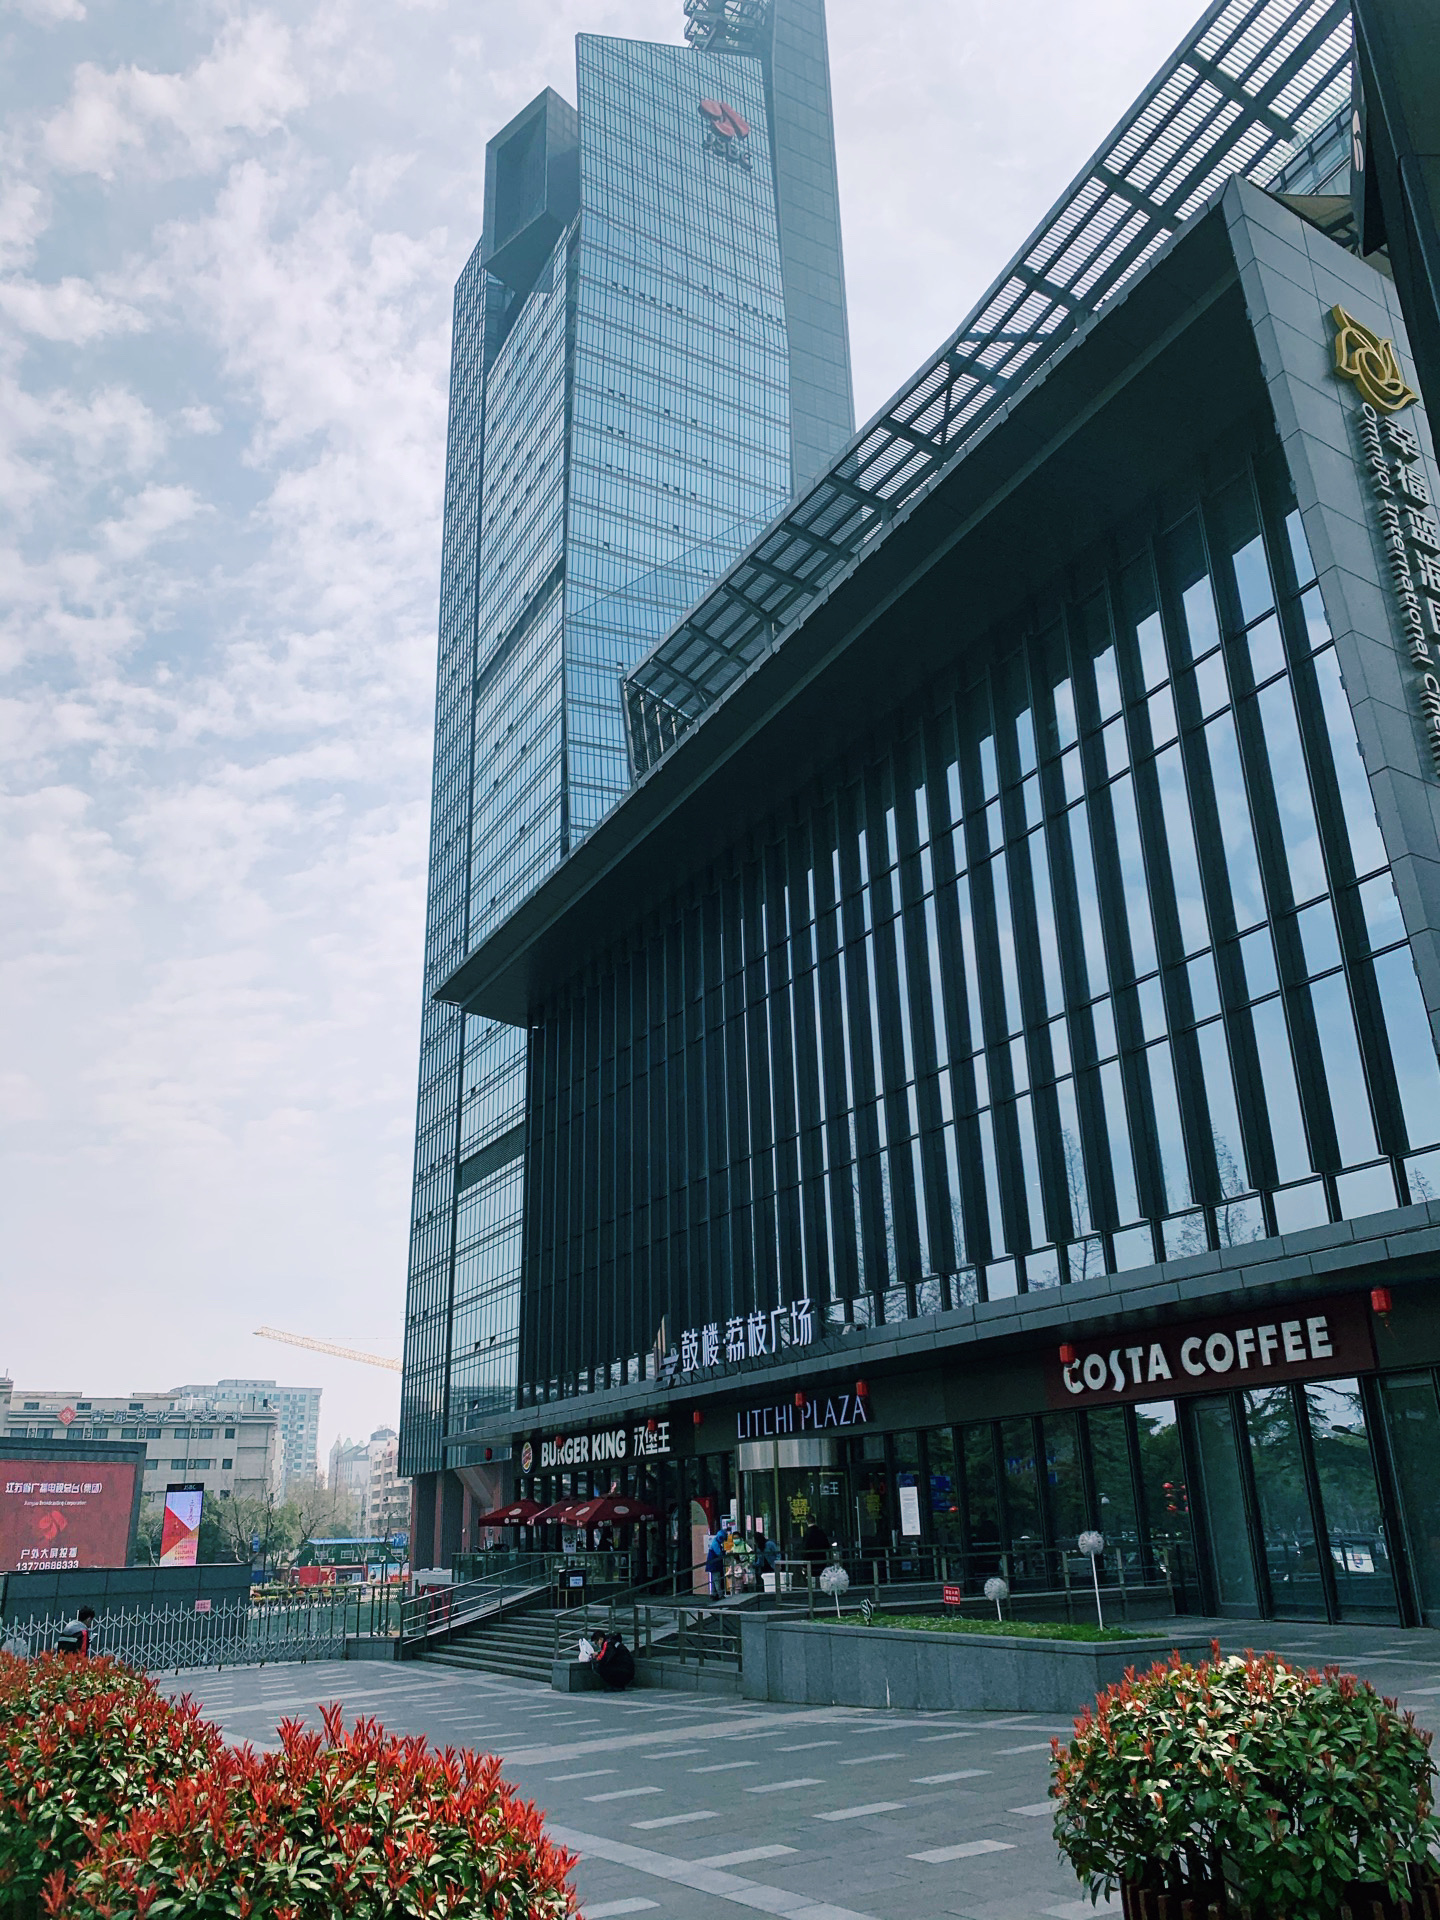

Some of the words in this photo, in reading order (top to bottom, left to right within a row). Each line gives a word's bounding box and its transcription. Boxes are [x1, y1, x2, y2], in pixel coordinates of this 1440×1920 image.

[1382, 499, 1434, 665] International
[1063, 1343, 1172, 1394] COSTA
[1181, 1316, 1333, 1376] COFFEE
[633, 1421, 671, 1456] 汉堡王
[737, 1403, 793, 1439] LITCHI
[801, 1394, 867, 1430] PLAZA
[541, 1435, 589, 1467] BURGER
[591, 1429, 626, 1461] KING
